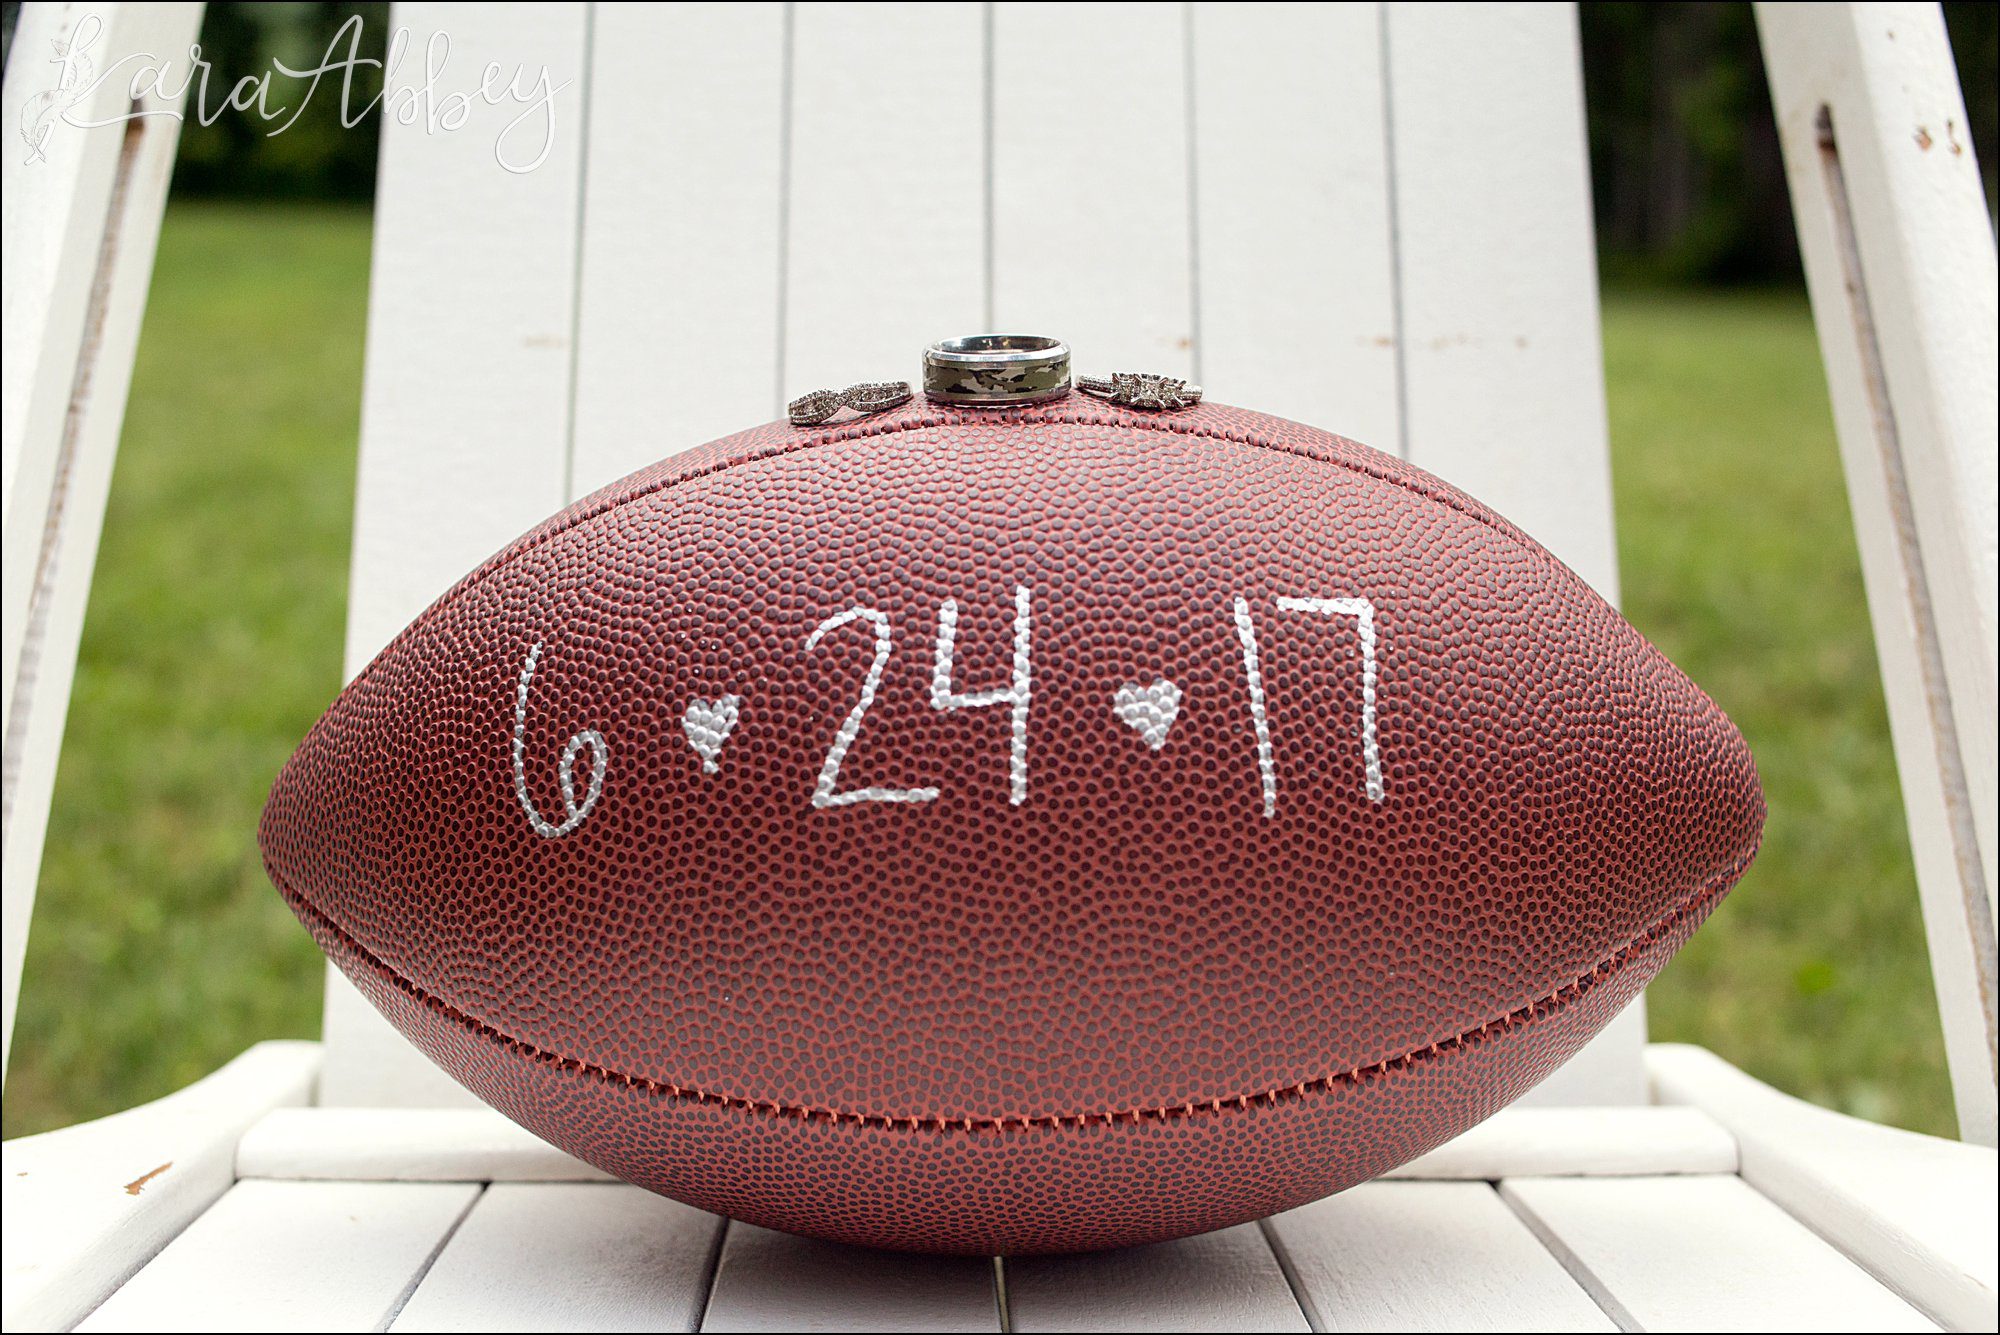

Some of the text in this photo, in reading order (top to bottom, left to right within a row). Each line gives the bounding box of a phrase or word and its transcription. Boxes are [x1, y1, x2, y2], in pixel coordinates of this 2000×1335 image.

[514, 585, 1387, 838] 6 24 17
